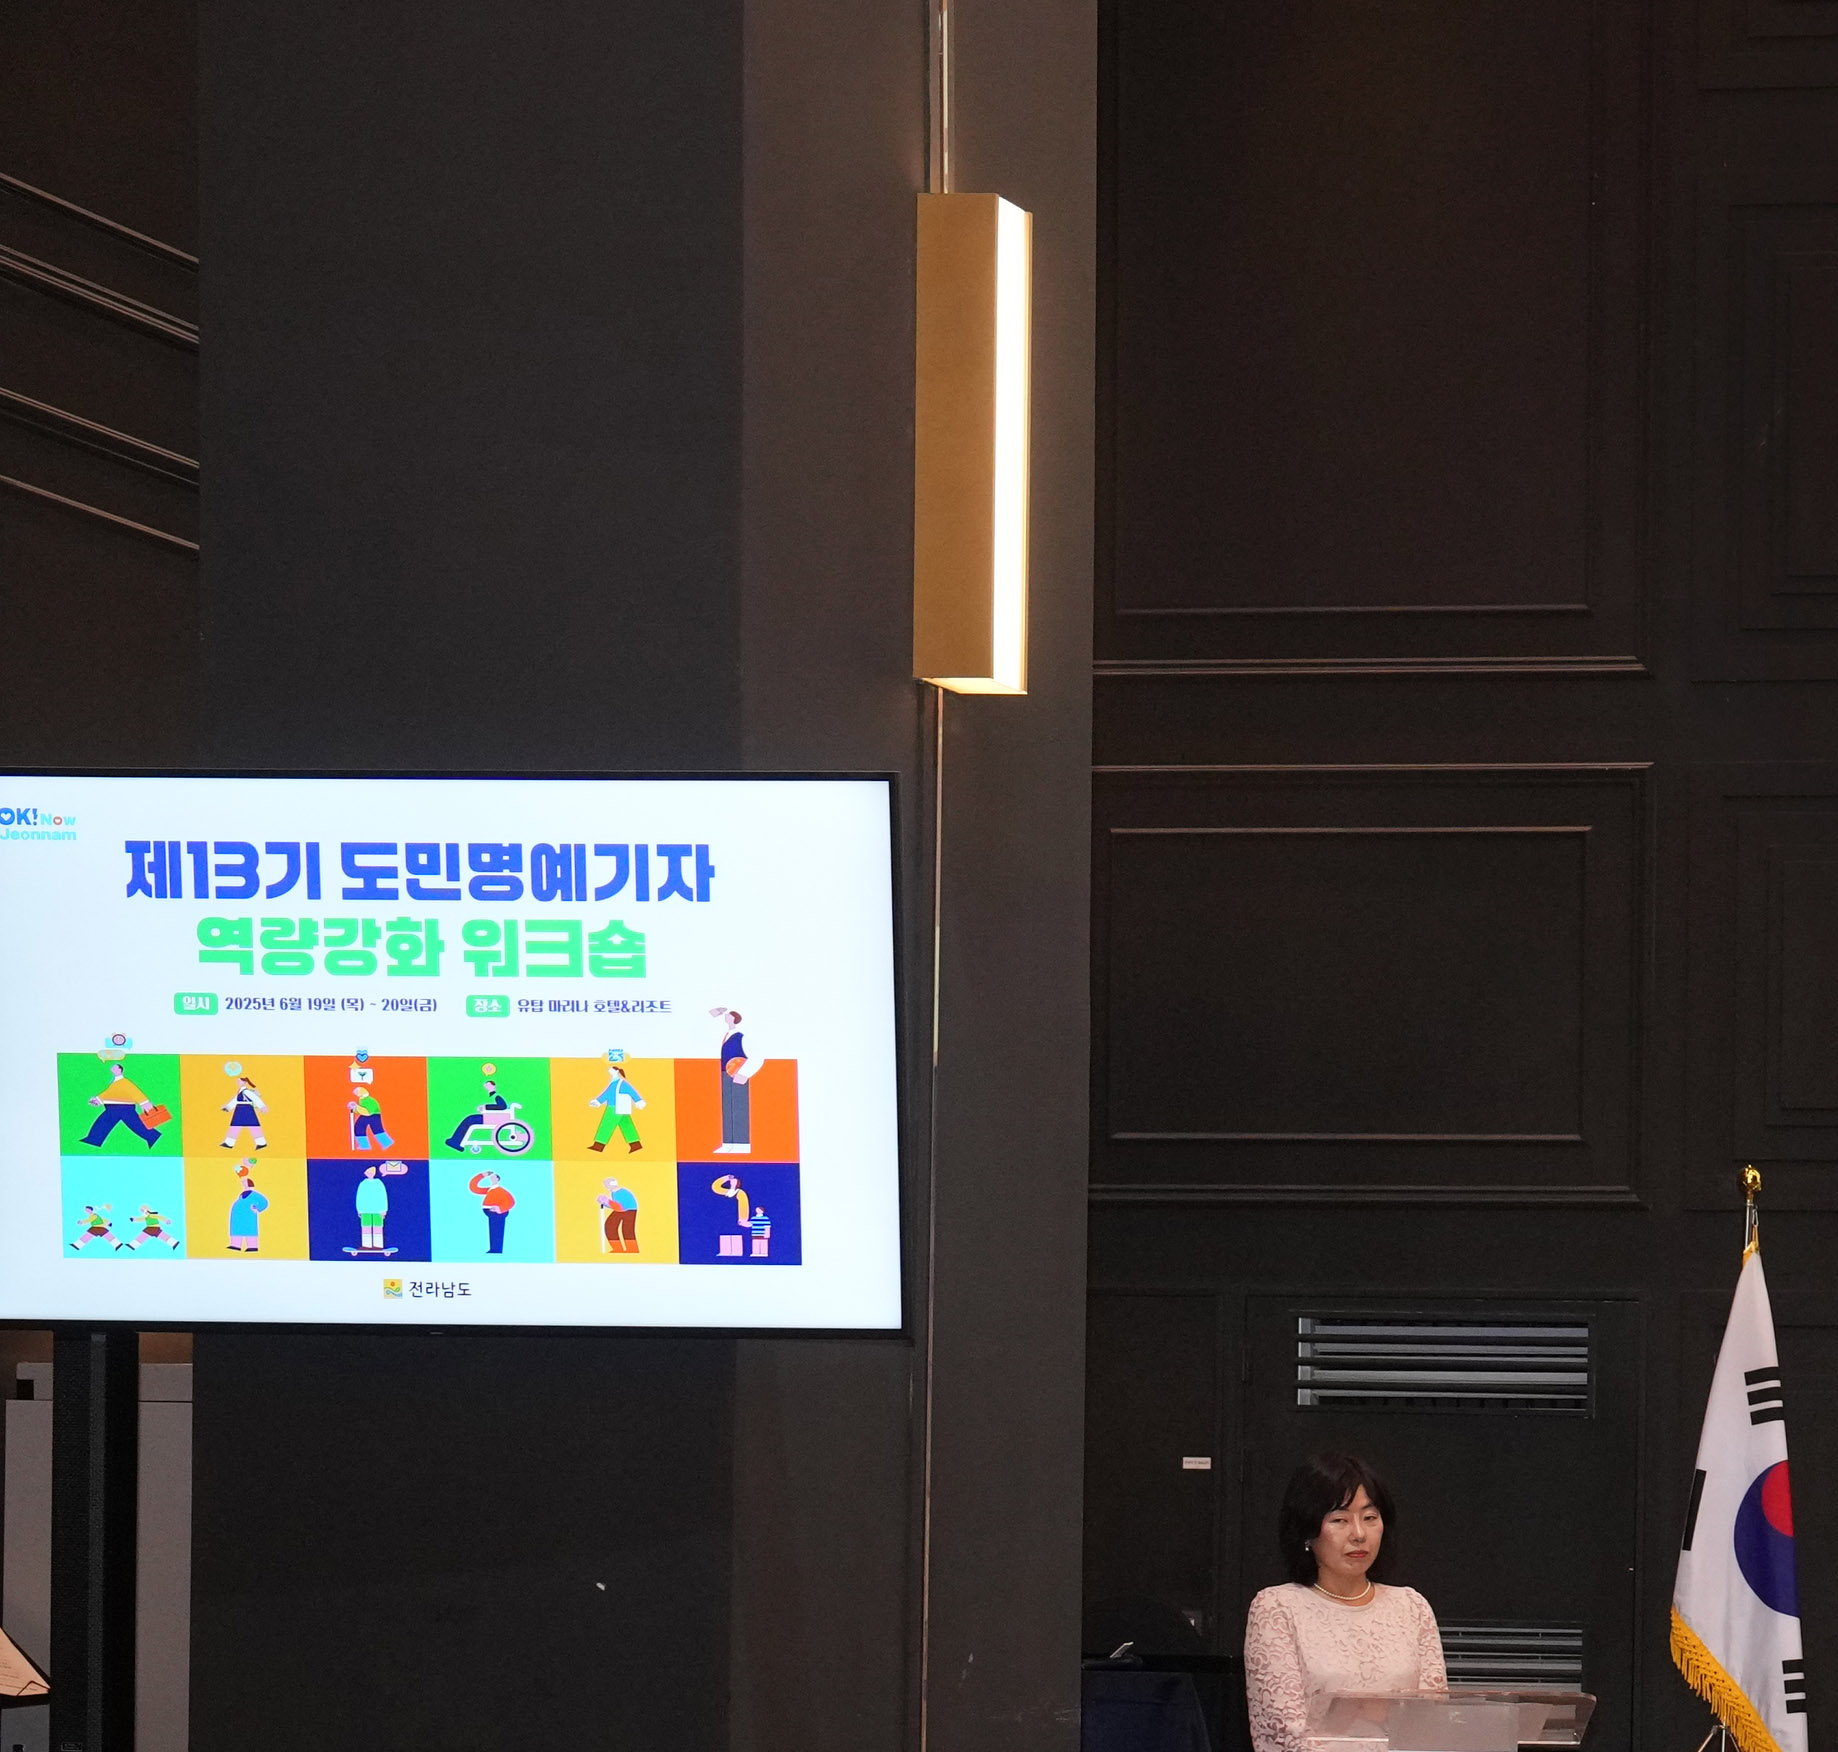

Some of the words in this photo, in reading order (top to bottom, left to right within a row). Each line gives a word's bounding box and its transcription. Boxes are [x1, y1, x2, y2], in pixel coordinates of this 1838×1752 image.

[0, 808, 38, 825] OK!
[40, 813, 76, 826] Now
[0, 828, 76, 840] Jeonnam
[125, 841, 321, 900] 제13기
[341, 842, 715, 902] 도민명예기자
[197, 917, 444, 976] 역량강화
[462, 920, 646, 978] 워크숍
[183, 996, 210, 1010] 일시
[226, 998, 274, 1010] 2025년
[280, 998, 301, 1010] 6월
[308, 998, 335, 1010] 19일
[341, 999, 364, 1011] (목)
[382, 999, 436, 1011] 20일(금)
[475, 998, 500, 1013] 장소
[518, 999, 543, 1012] 유탑
[549, 1000, 588, 1012] 마리나
[595, 999, 672, 1013] 호텔&리조트
[410, 1282, 471, 1298] 전라남도
